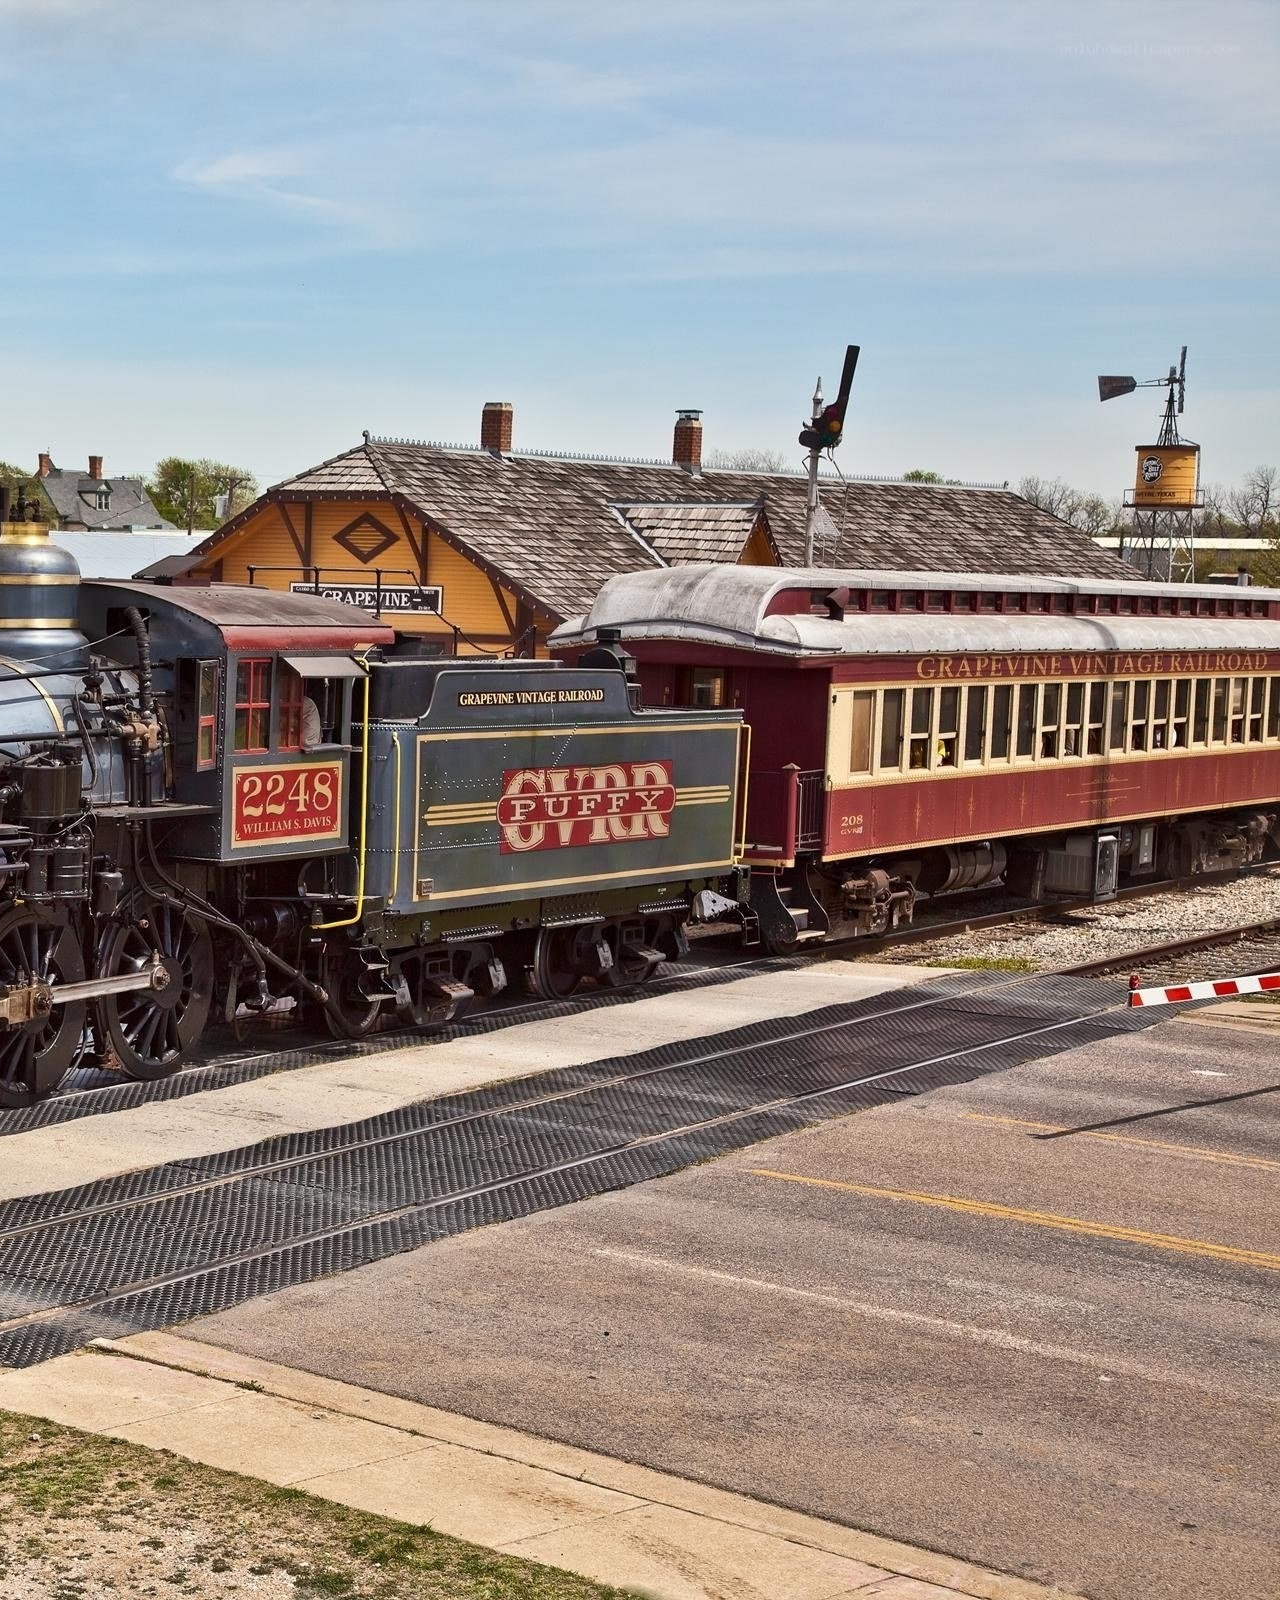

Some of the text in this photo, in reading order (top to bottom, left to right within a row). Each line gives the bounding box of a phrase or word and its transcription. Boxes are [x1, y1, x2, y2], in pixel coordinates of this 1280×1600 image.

[321, 589, 411, 607] GRAPEVINE
[916, 652, 1268, 679] GRAPEVINE VINTAGE RAILROAD
[459, 689, 604, 706] GRAPEVINE VINTAGE RAILROAD
[242, 771, 333, 817] 2248
[510, 790, 665, 821] PUFFY
[503, 762, 670, 851] GVRR
[243, 815, 332, 835] WILLIAM S. DAVIS
[841, 814, 863, 827] 208
